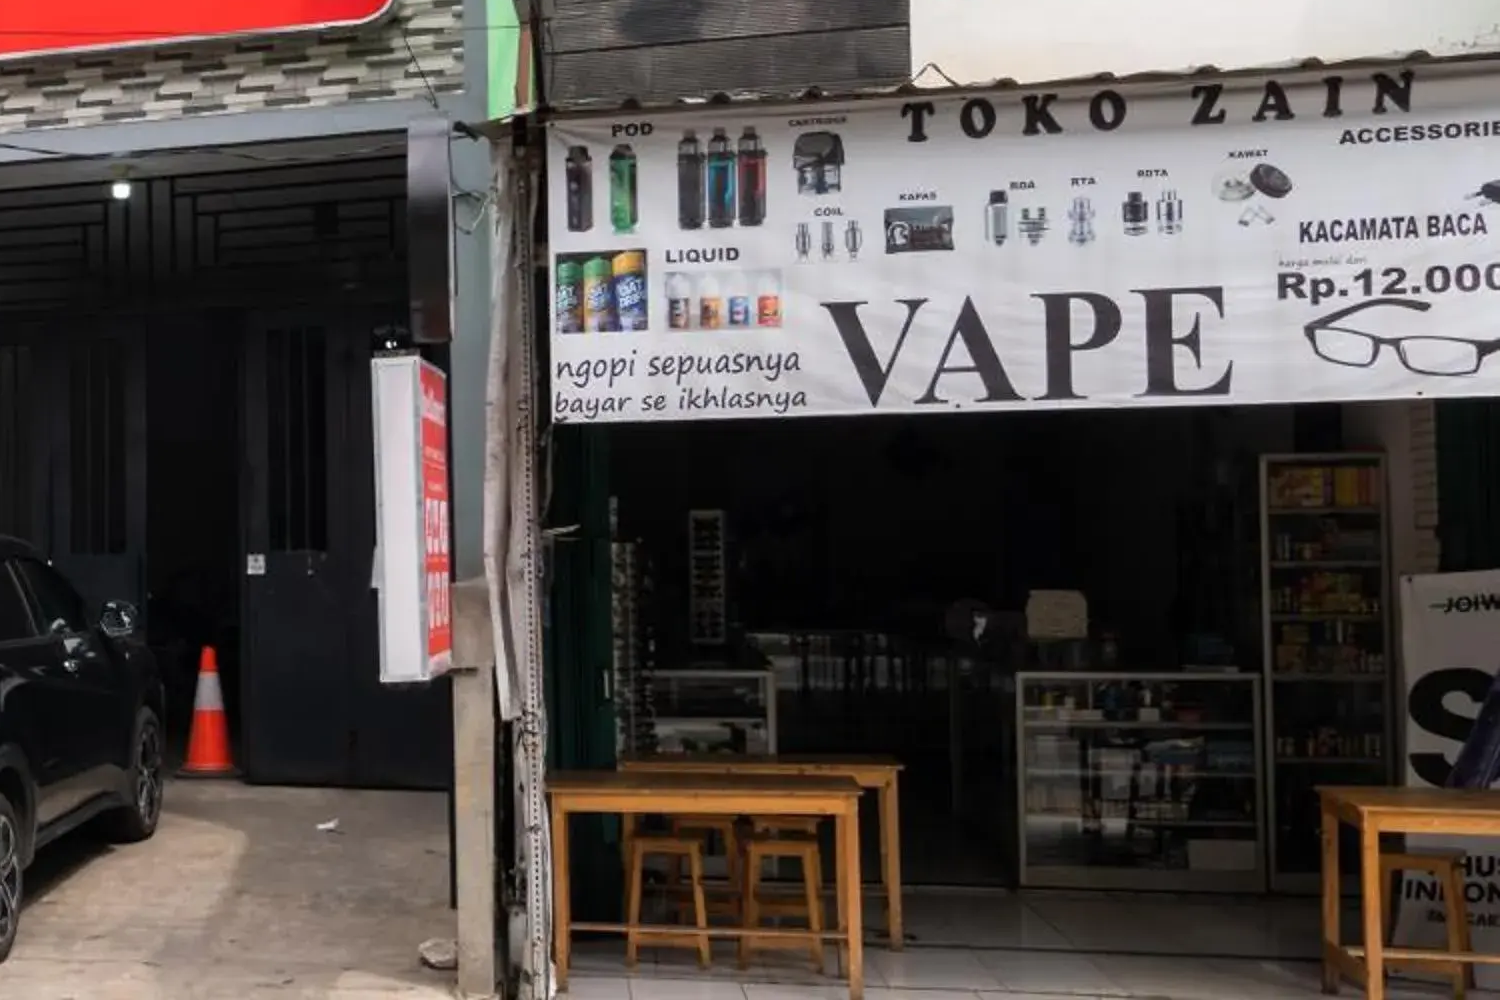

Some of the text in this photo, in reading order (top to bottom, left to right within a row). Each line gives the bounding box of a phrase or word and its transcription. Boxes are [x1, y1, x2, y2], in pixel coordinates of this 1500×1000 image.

[900, 70, 1415, 142] TOKO ZAIN
[611, 123, 654, 137] POD
[813, 207, 844, 217] COIL
[1299, 213, 1488, 243] KACAMATA BACA
[665, 247, 739, 264] LIQUID
[820, 286, 1233, 408] VAPE
[556, 350, 801, 388] ngopi sepuasnya
[554, 387, 808, 419] bayar se ikhlasnya
